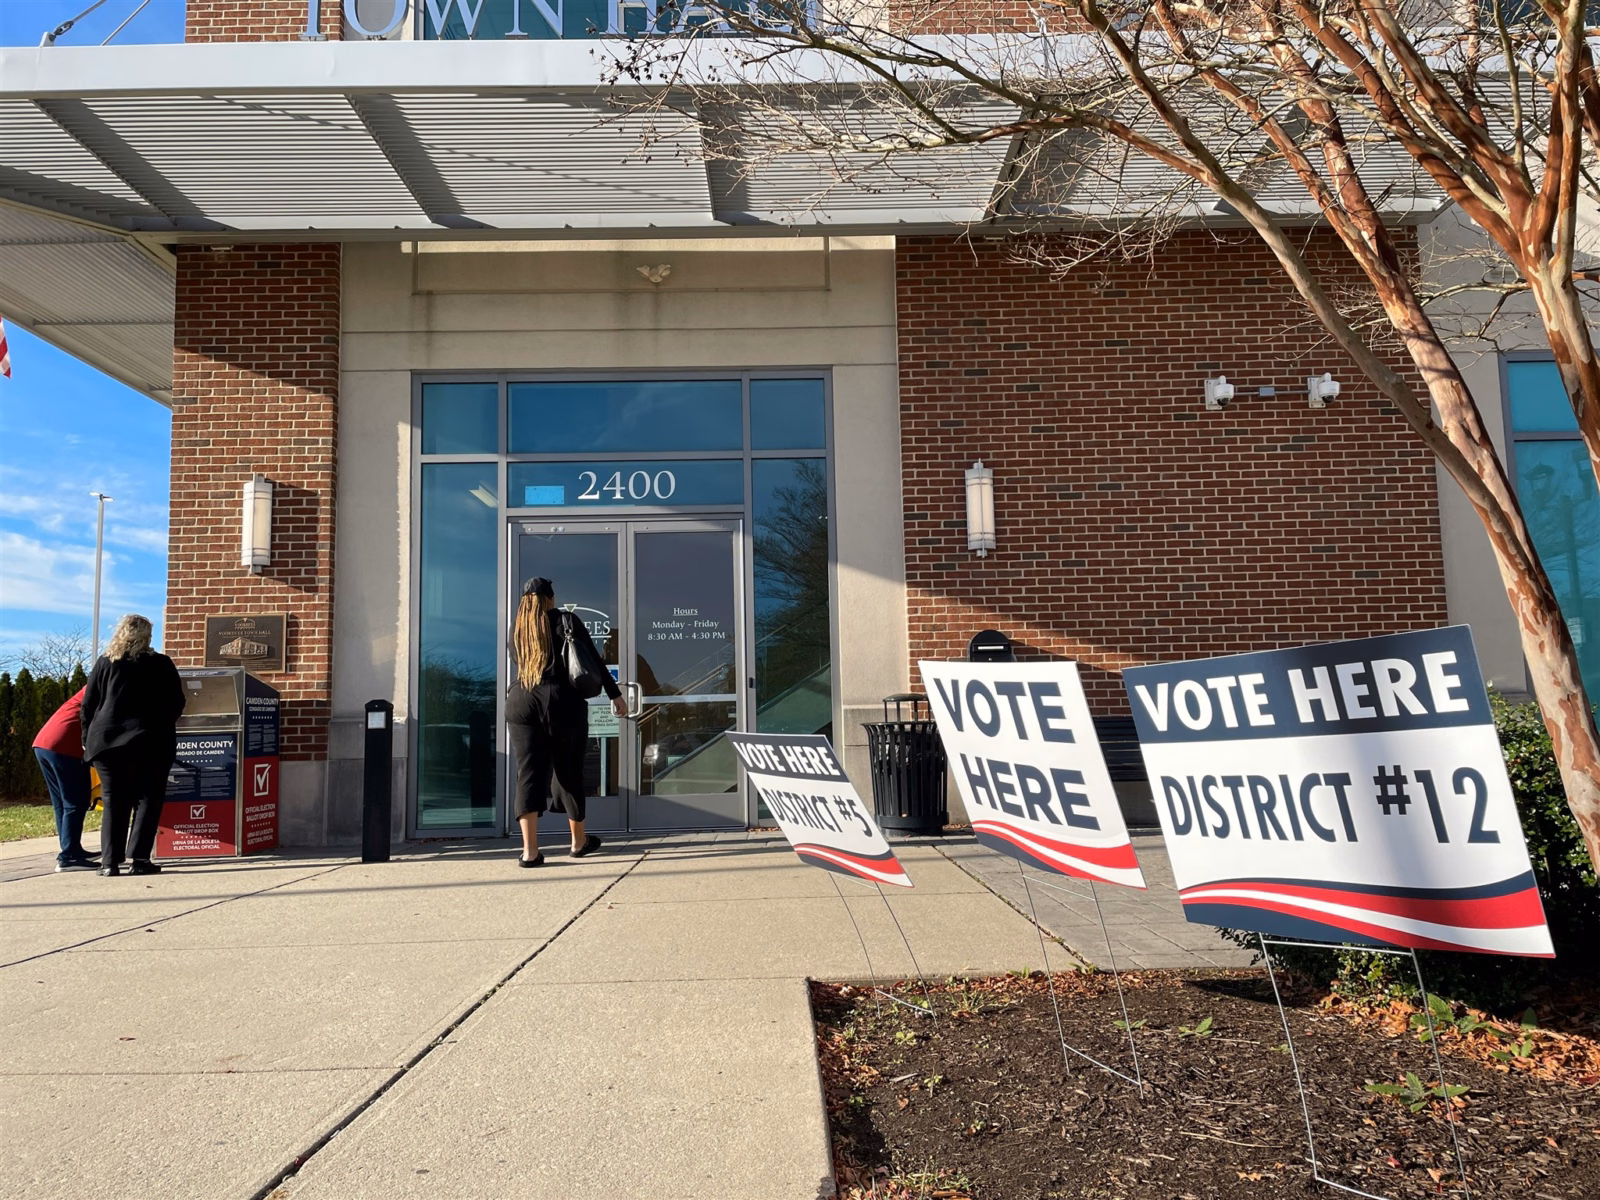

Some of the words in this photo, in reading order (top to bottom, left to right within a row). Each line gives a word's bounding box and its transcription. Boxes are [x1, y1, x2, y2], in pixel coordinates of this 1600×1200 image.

[577, 470, 676, 500] 2400
[652, 620, 686, 630] Monday
[694, 620, 720, 630] Friday
[673, 607, 698, 616] Hours
[932, 678, 1076, 744] VOTE
[1135, 672, 1276, 732] VOTE
[1288, 650, 1470, 724] HERE
[176, 742, 198, 750] MDEN
[199, 740, 234, 748] COUNTY
[733, 742, 786, 772] VOTE
[779, 745, 841, 776] HERE
[762, 787, 843, 833] DISTRICT
[832, 794, 873, 838] #5
[960, 752, 1102, 832] HERE
[1160, 772, 1359, 843] DISTRICT
[1372, 764, 1501, 845] #12
